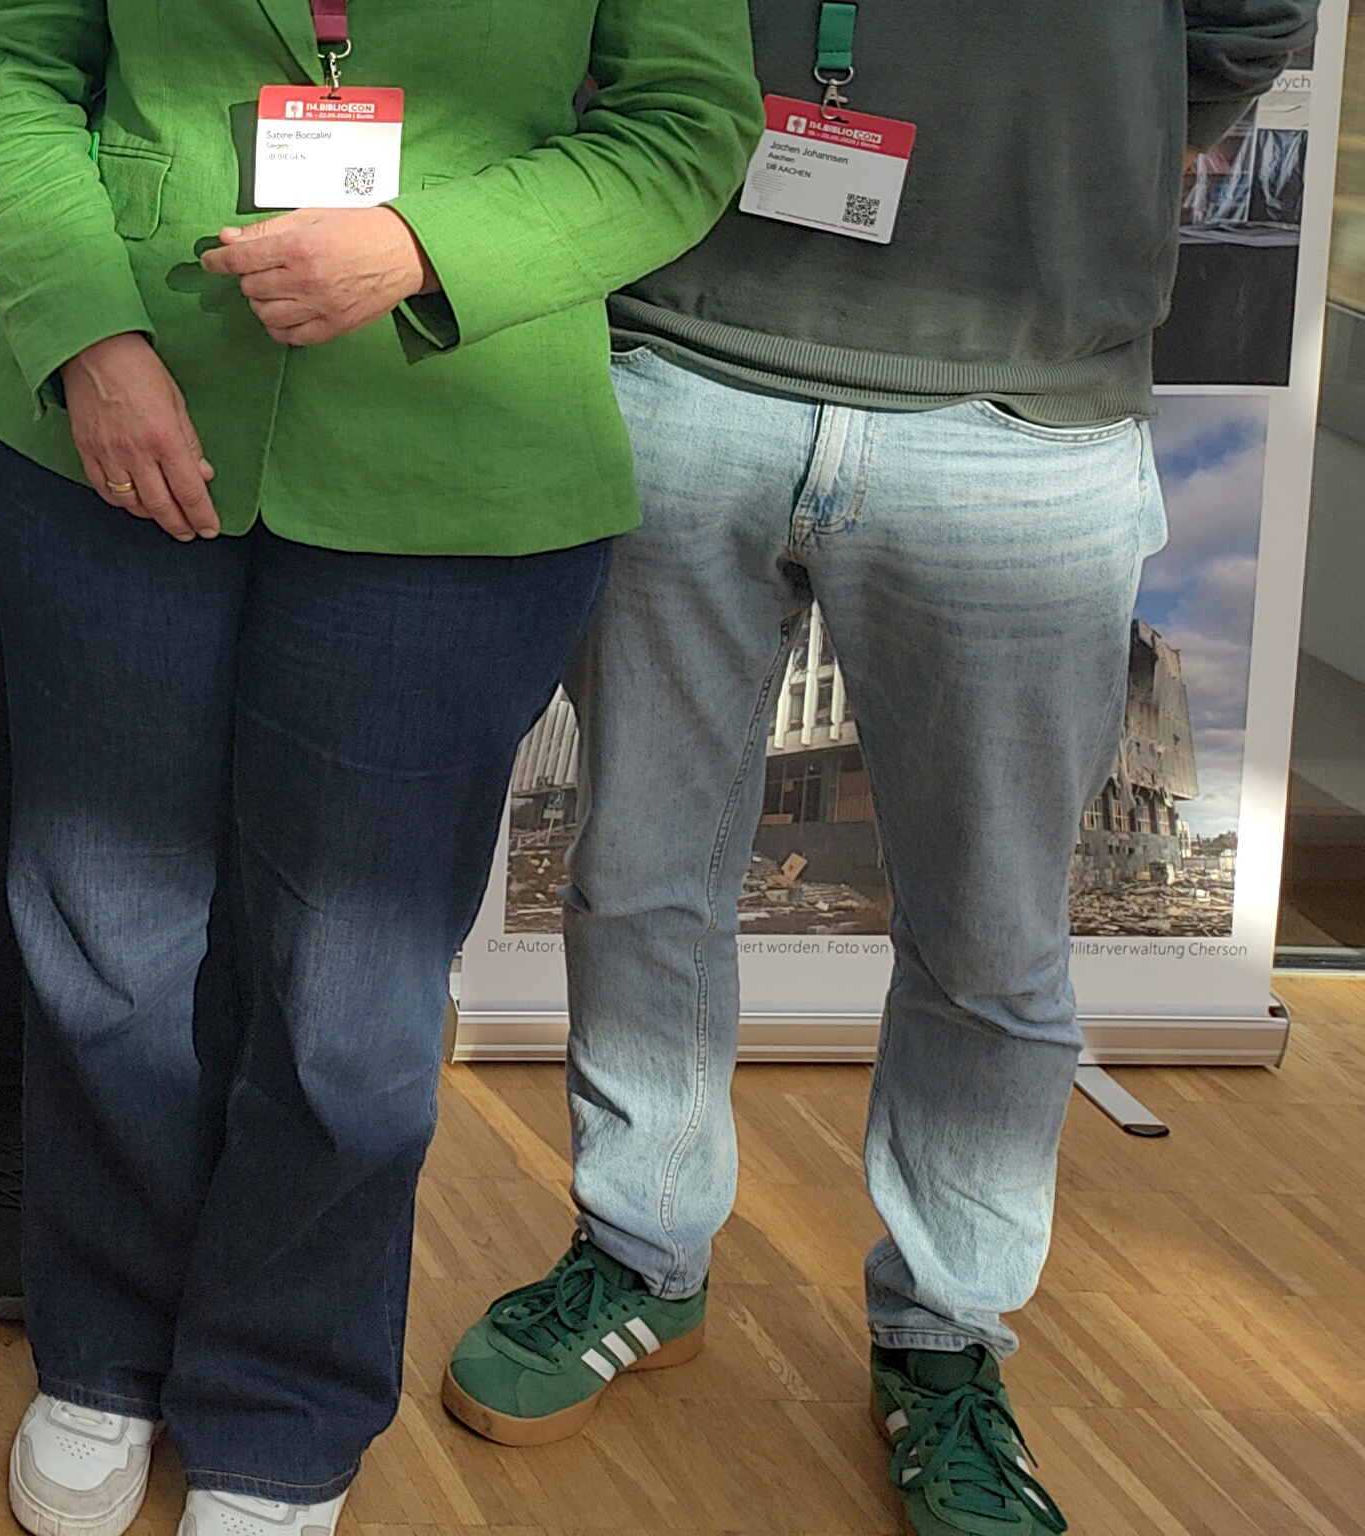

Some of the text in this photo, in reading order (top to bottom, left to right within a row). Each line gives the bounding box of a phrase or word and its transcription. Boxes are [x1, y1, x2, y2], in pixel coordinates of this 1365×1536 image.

[770, 141, 848, 164] Jochen Johannsen
[778, 165, 811, 178] AACHEN
[487, 940, 512, 953] Der
[515, 939, 556, 953] Autor
[767, 940, 823, 954] worden.
[827, 940, 859, 954] Foto
[863, 944, 888, 955] von
[1188, 942, 1247, 956] Cherson
